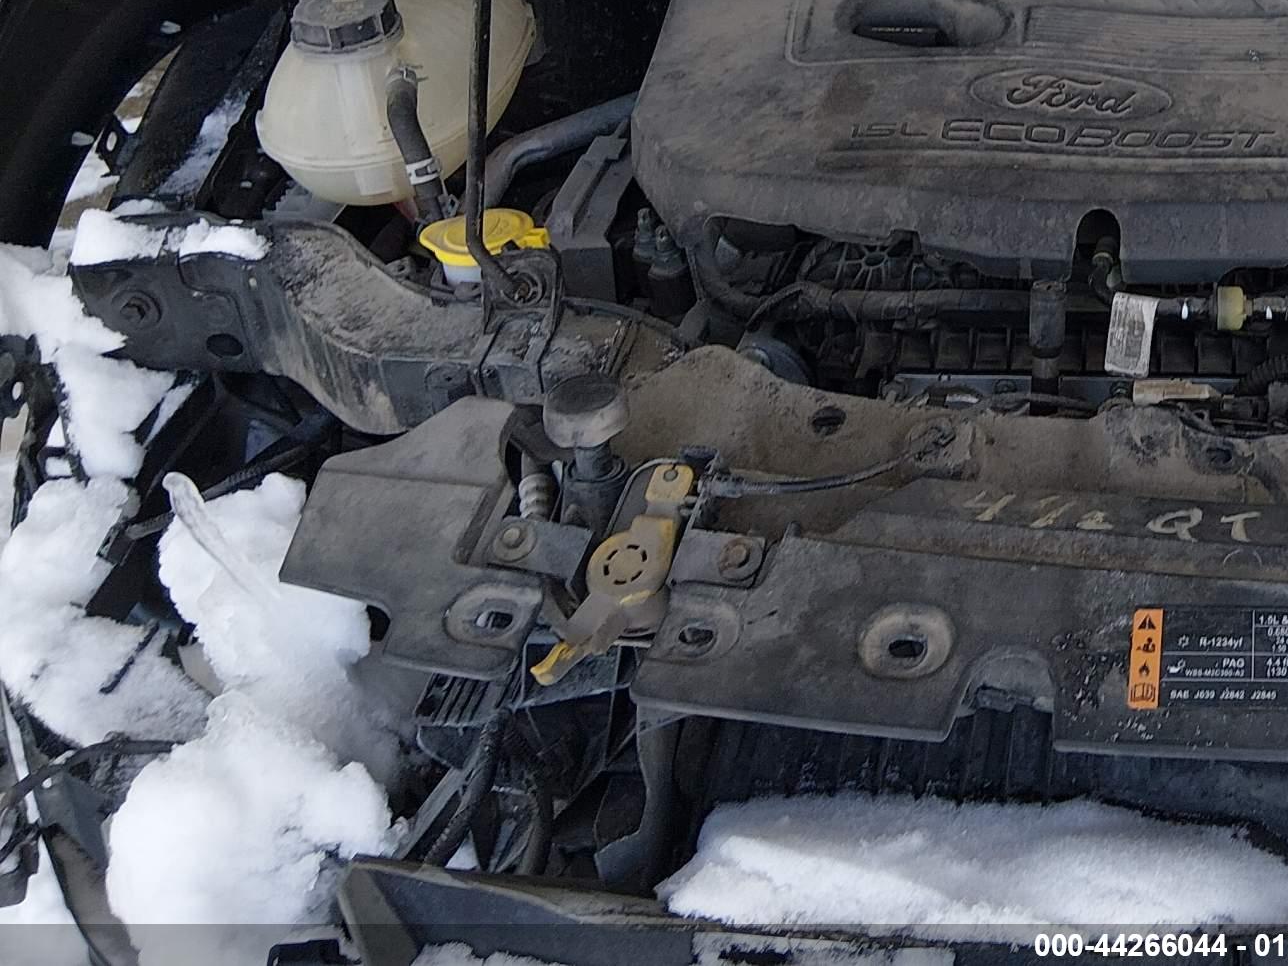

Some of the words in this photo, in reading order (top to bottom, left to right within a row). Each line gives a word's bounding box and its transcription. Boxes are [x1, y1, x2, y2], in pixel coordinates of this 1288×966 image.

[1005, 71, 1137, 115] Ford
[1145, 507, 1262, 543] QT
[1199, 636, 1244, 650] R-1234yf
